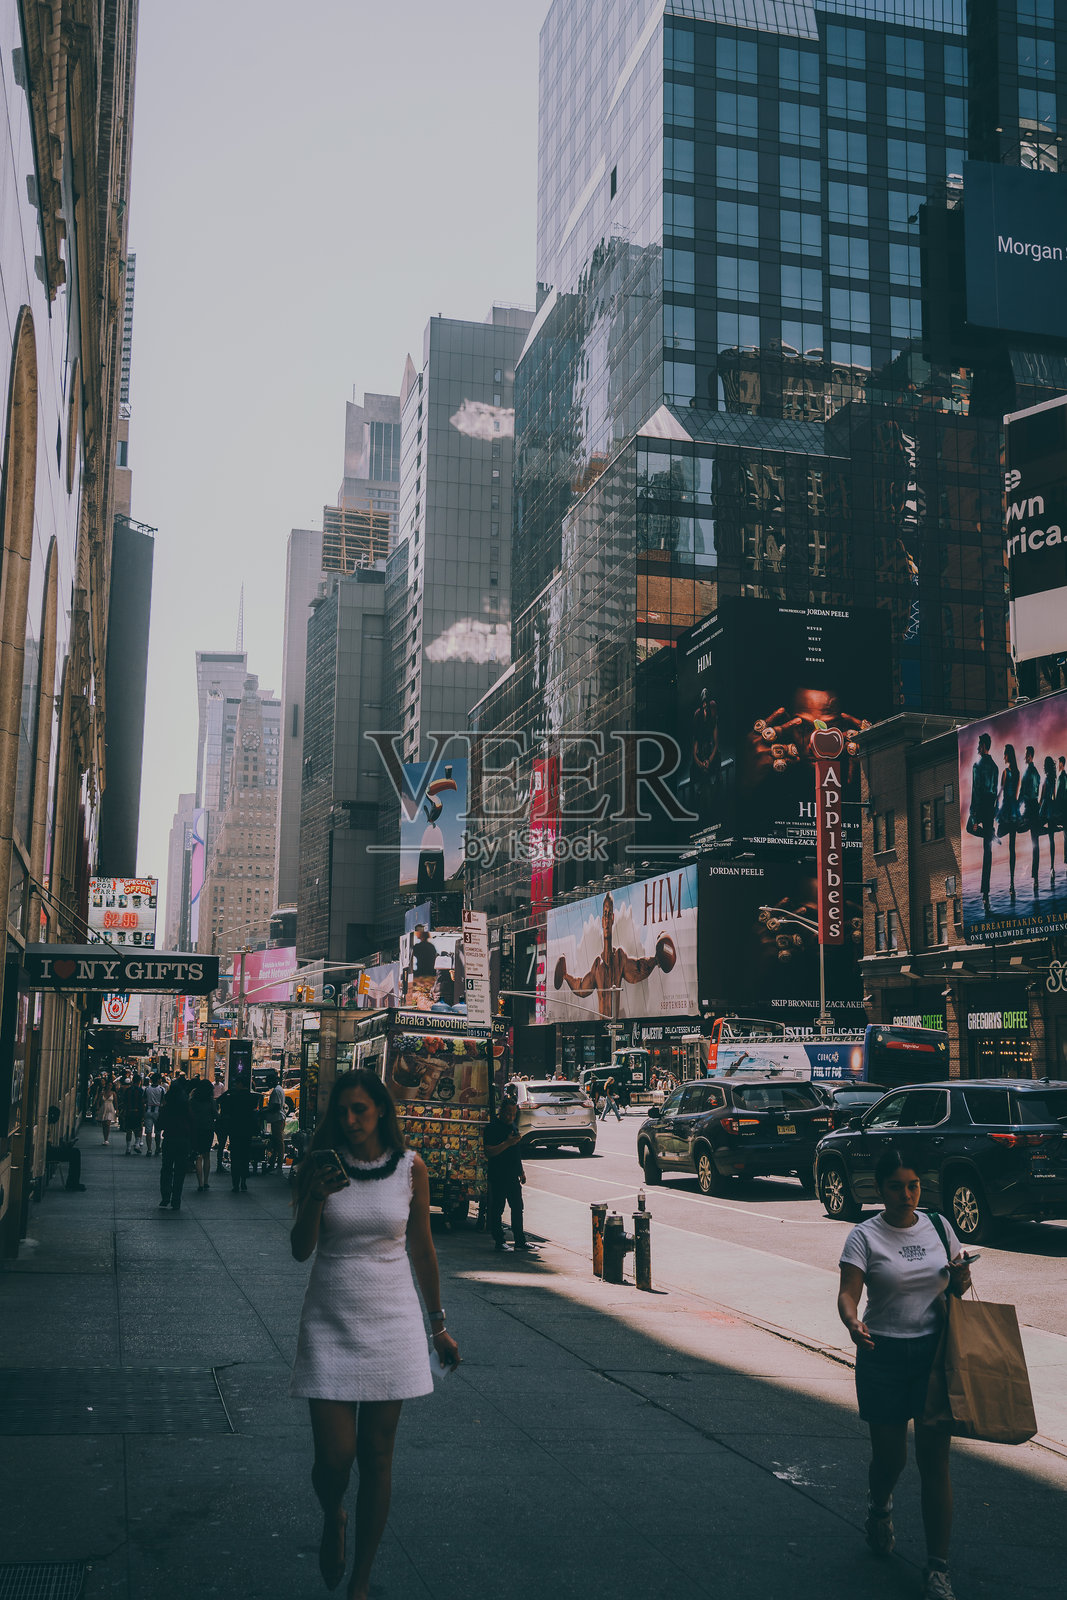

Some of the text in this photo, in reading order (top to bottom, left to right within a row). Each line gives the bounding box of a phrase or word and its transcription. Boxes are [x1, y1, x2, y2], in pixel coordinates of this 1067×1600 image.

[998, 236, 1062, 262] Morgan
[807, 608, 830, 616] JORDAN
[698, 651, 712, 673] HIM
[767, 837, 793, 845] BRONKIE
[798, 838, 815, 846] ZACK
[821, 766, 844, 939] Applebee's
[709, 866, 765, 877] JORDAN PEELE
[123, 879, 152, 887] SPECIAL
[124, 885, 152, 896] OFFER
[643, 873, 684, 926] HIM
[103, 911, 138, 929] $2.99
[981, 915, 1043, 932] BREATHTAKING
[984, 928, 1024, 939] WORLDWIDE
[40, 959, 52, 979] I
[124, 961, 205, 981] GIFTS
[660, 1000, 688, 1010] SEPTEMBER
[788, 1000, 820, 1008] BRONKIE
[845, 1001, 865, 1009] AKER
[395, 1013, 425, 1026] Baraka
[922, 1013, 944, 1031] COFFEE
[968, 1011, 1028, 1030] GREGORYS COFFEE
[641, 1027, 663, 1040] MAJESTIC
[665, 1026, 690, 1034] DELICATESSEN
[691, 1026, 701, 1034] CAFE
